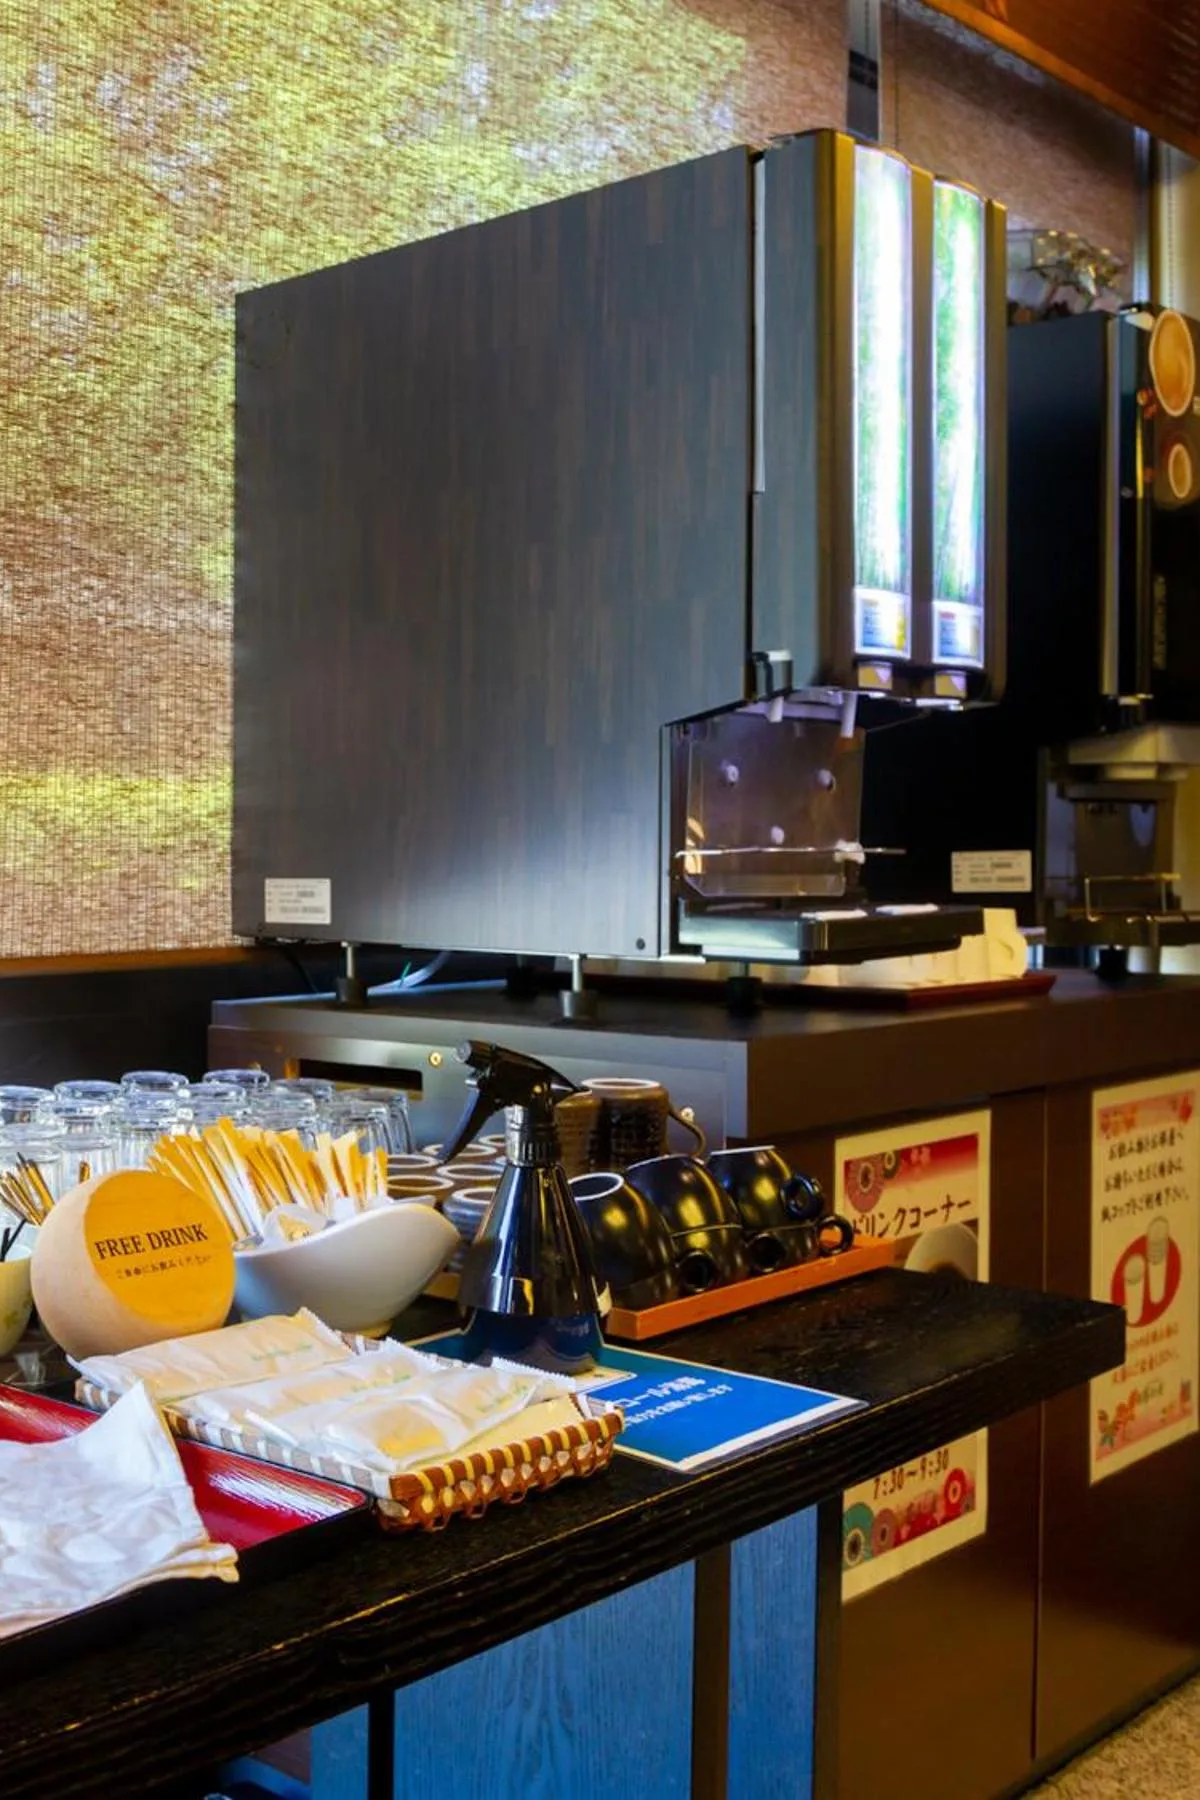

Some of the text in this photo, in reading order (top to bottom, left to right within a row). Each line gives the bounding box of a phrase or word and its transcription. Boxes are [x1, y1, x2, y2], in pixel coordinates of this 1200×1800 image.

[853, 1193, 972, 1239] ドリンクコーナー
[94, 1223, 209, 1260] FREE DRINK
